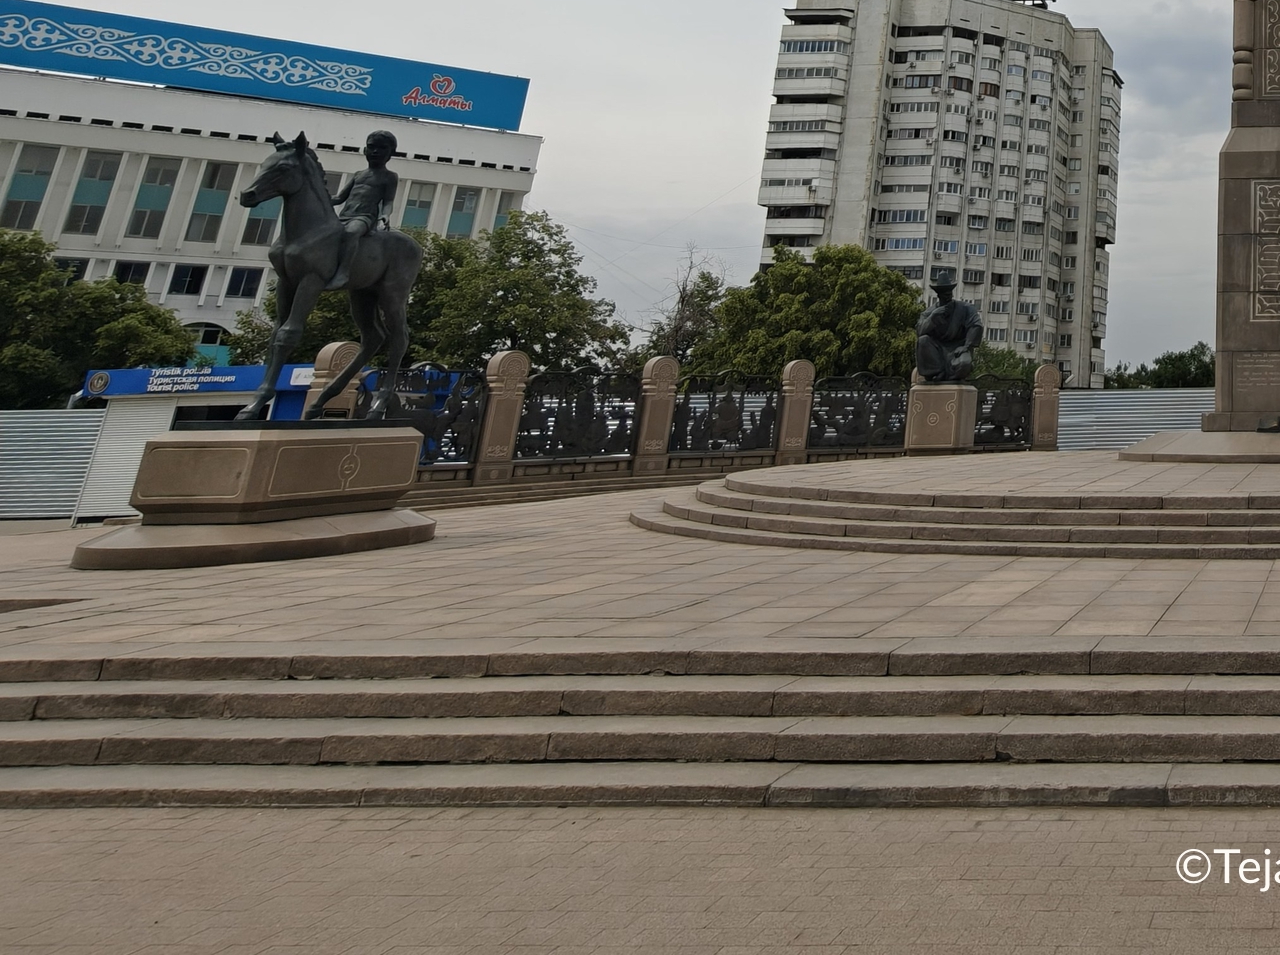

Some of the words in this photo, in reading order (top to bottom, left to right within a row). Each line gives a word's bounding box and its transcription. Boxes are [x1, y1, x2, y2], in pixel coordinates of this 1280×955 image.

[402, 86, 473, 112] Алматы
[198, 375, 236, 383] полиция
[147, 384, 172, 392] Tourist
[172, 383, 199, 393] police
